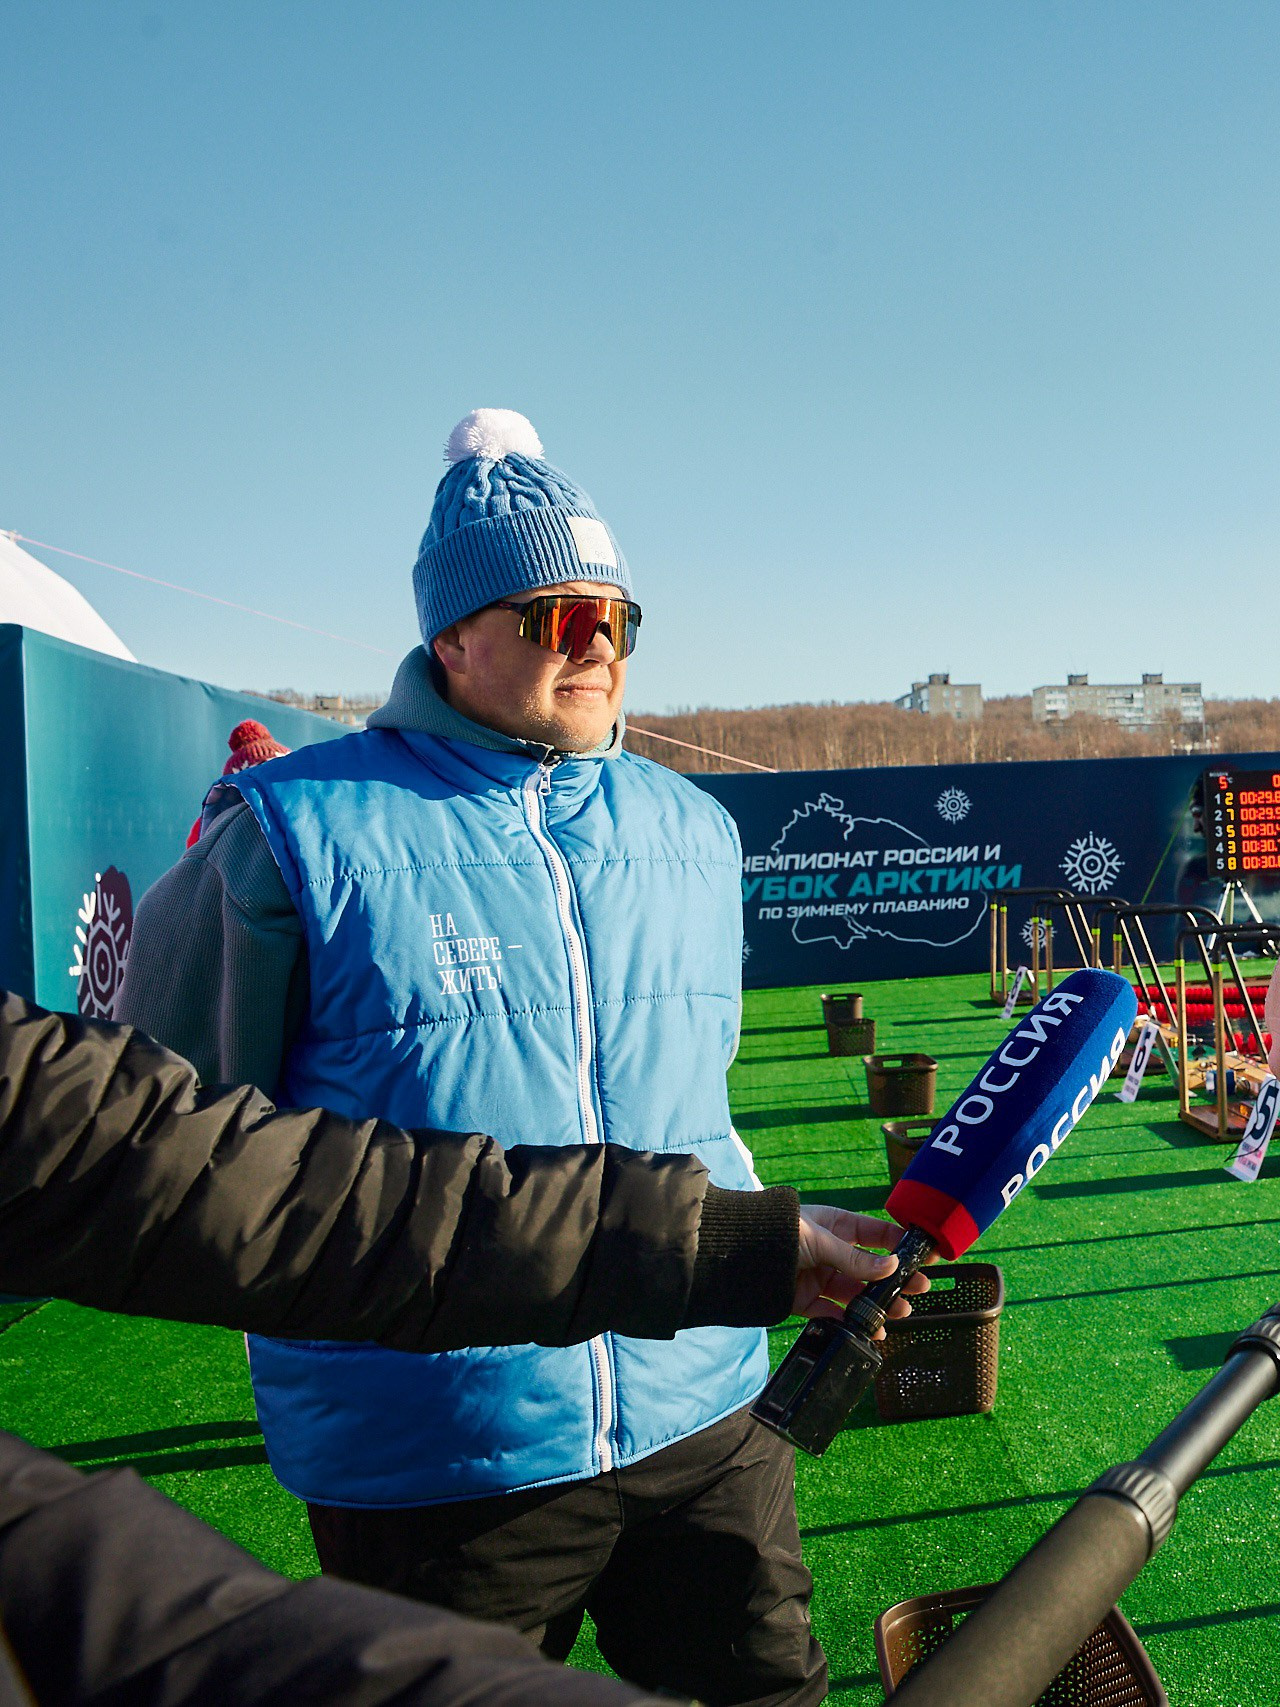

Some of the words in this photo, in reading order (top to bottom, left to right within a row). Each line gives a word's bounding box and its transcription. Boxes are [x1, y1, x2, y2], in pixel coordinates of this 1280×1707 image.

[1214, 793, 1221, 805] 1
[1224, 792, 1234, 806] 2
[1214, 809, 1223, 821] 2
[1226, 808, 1235, 821] 7
[1215, 825, 1223, 838] 3
[1226, 824, 1236, 838] 5
[883, 845, 979, 867] РОССИИ
[984, 844, 1001, 861] И
[1215, 842, 1224, 854] 4
[1227, 840, 1236, 854] 3
[1216, 858, 1224, 870] 5
[1227, 856, 1237, 871] 8
[741, 873, 840, 903] УБОК
[847, 864, 1023, 897] АРКТИКИ
[758, 907, 783, 920] ПО
[787, 902, 869, 919] ЗИМНЕМУ
[872, 897, 970, 914] ПЛАВАНИЮ
[429, 912, 459, 938] НА
[433, 937, 502, 966] СЕВЕРЕ
[438, 965, 503, 995] ЖИТЬ!
[931, 992, 1084, 1156] РОССИЯ
[1250, 1084, 1280, 1140] 5
